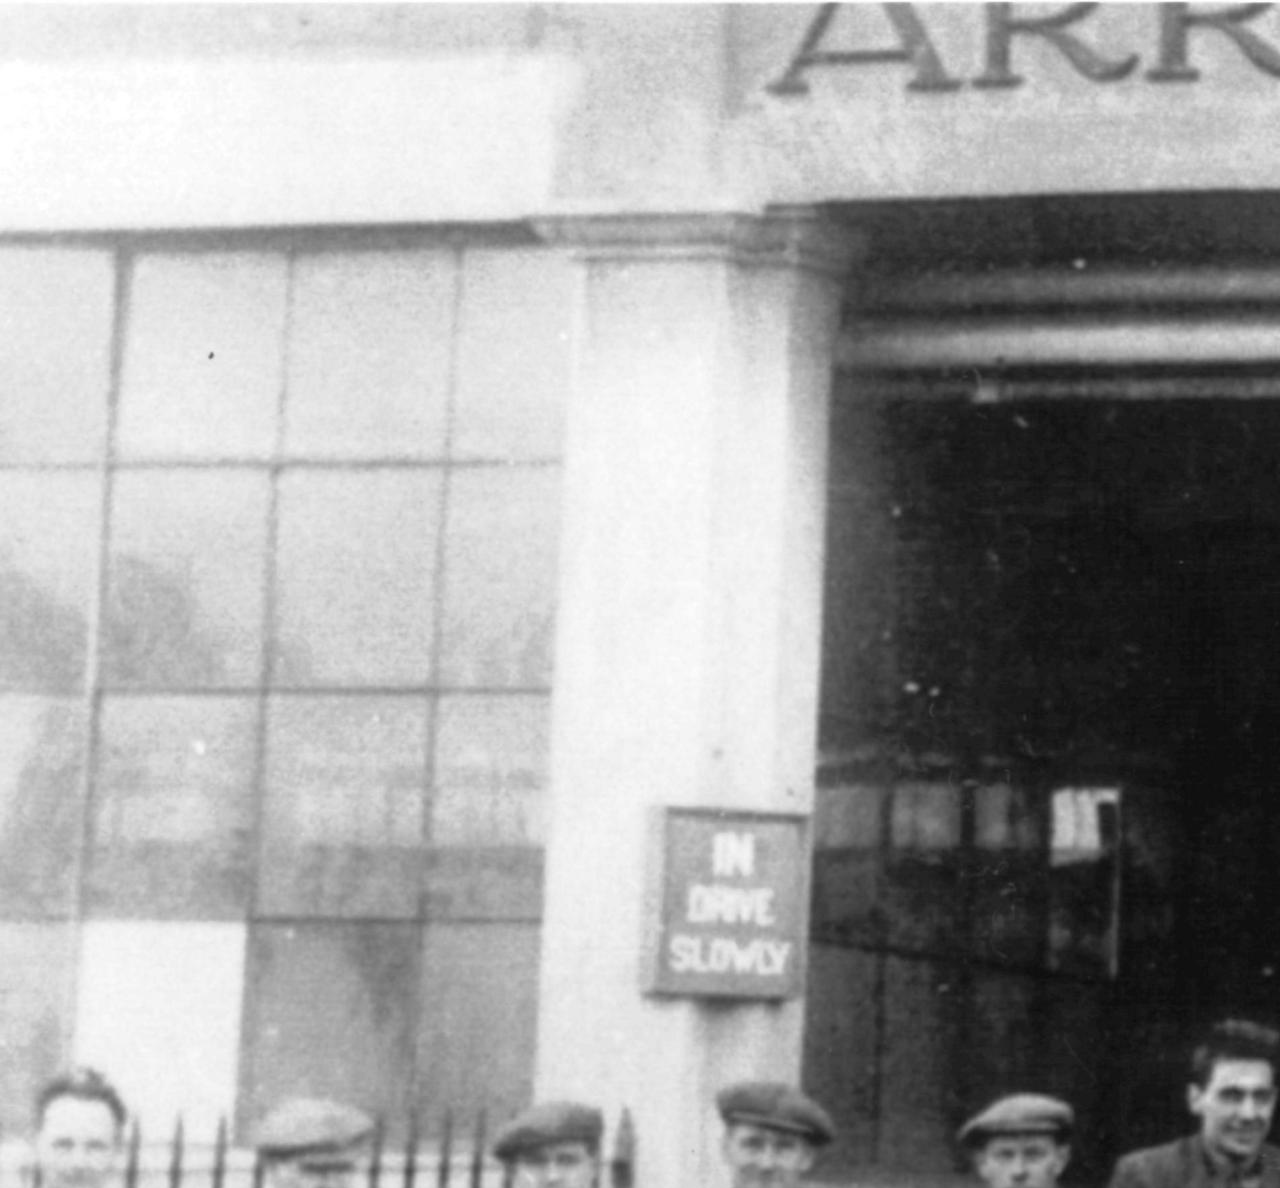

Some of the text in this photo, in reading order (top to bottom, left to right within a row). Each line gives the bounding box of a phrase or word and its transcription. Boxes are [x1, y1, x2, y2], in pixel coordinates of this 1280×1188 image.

[712, 832, 754, 876] IN
[687, 884, 776, 926] DRIVE
[669, 935, 791, 975] SLOWLY
